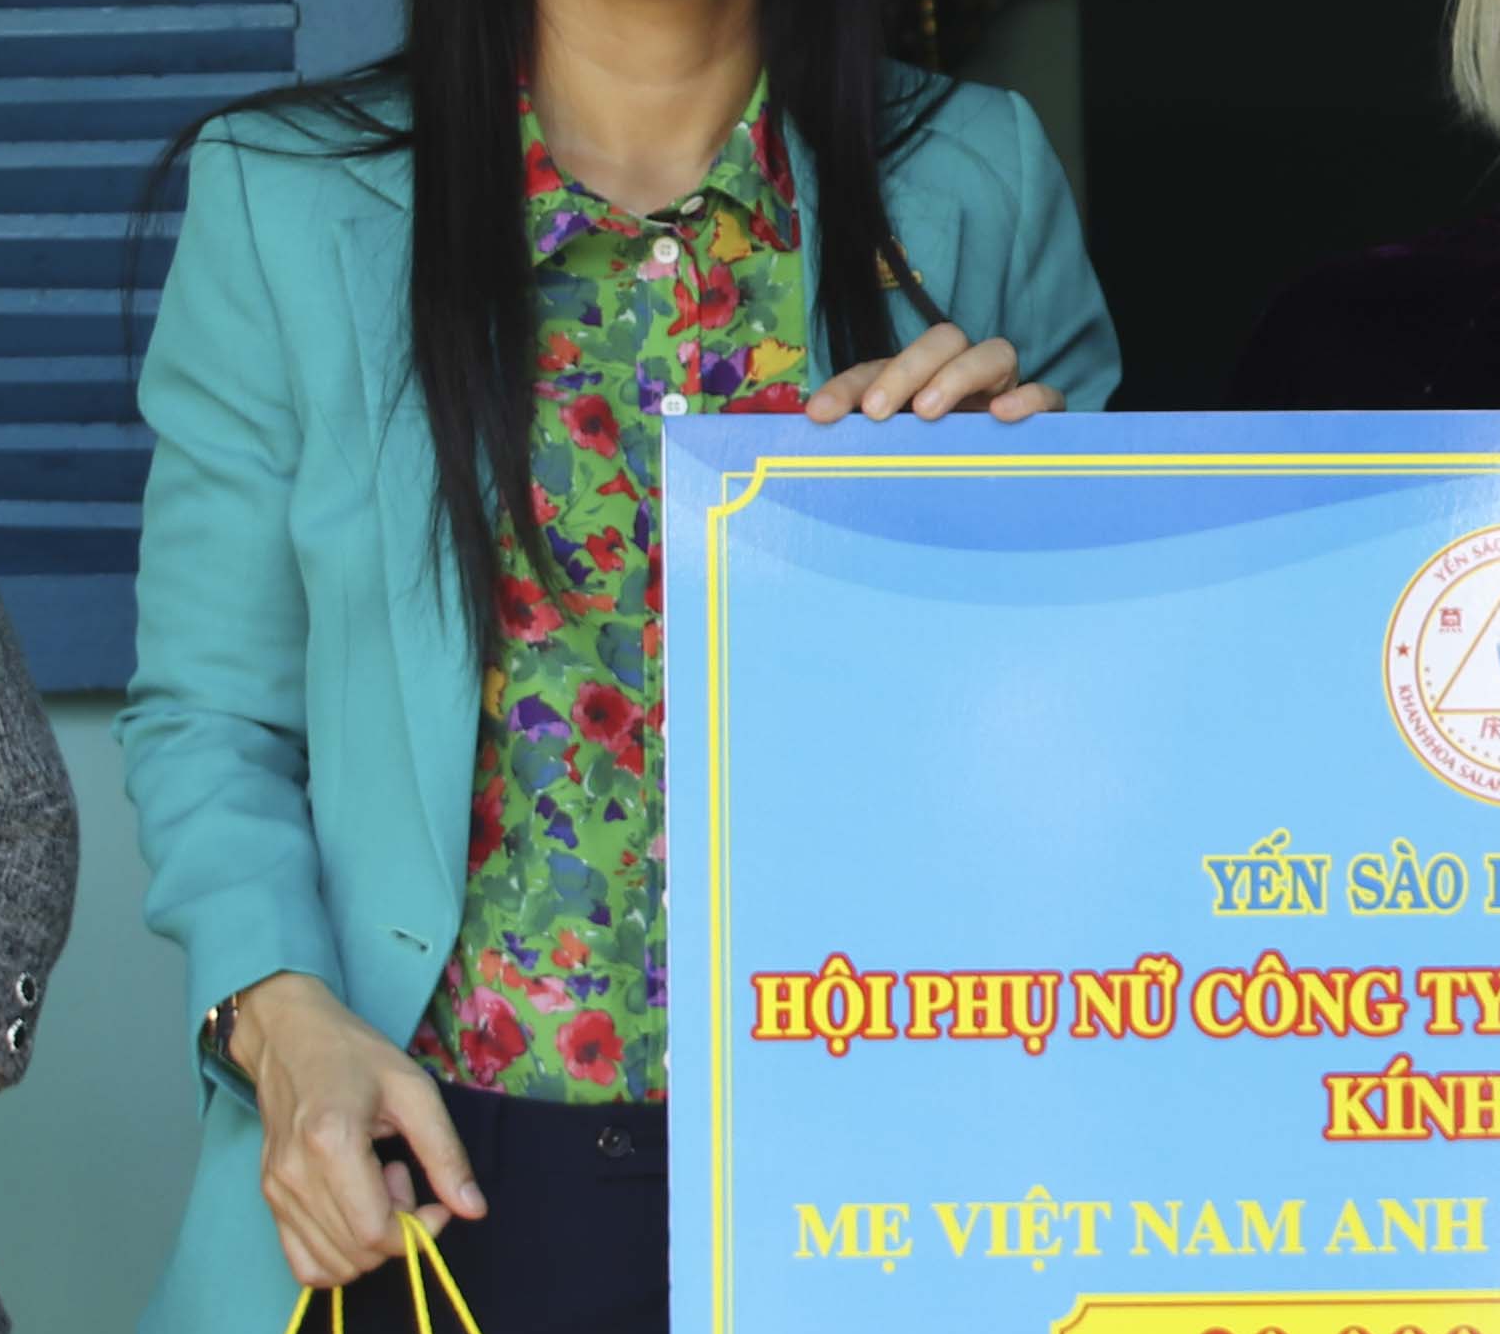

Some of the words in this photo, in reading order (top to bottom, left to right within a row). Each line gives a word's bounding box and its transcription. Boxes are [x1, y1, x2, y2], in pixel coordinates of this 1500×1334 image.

[1433, 552, 1469, 584] YẾN
[1202, 828, 1331, 915] YẾN
[1347, 838, 1469, 915] SÀO
[752, 952, 896, 1057] HỘI
[905, 971, 1059, 1056] PHỤ
[1071, 953, 1181, 1038] NỮ
[1191, 949, 1408, 1040] CÔNG
[792, 1201, 913, 1274] MẸ
[931, 1183, 1111, 1272] VIỆT
[1130, 1197, 1306, 1256] NAM
[1325, 1196, 1490, 1254] ANH
